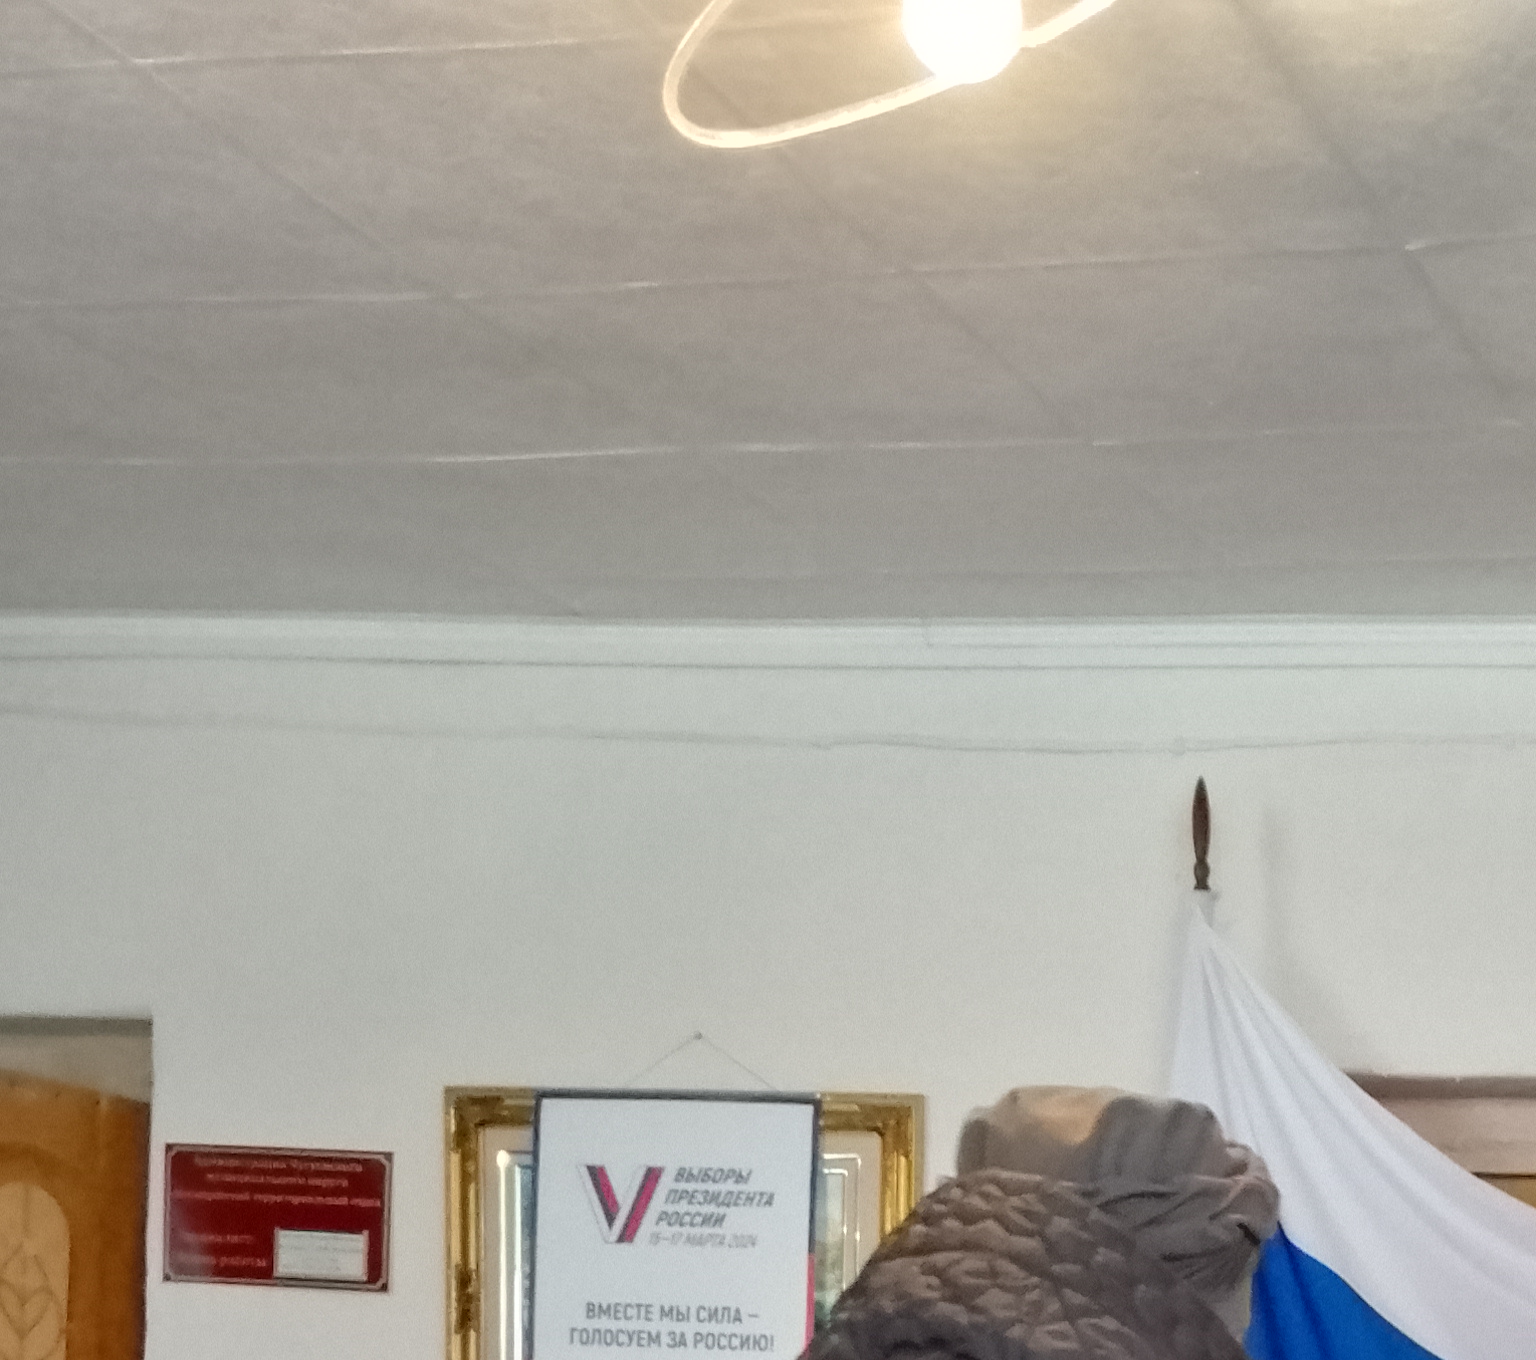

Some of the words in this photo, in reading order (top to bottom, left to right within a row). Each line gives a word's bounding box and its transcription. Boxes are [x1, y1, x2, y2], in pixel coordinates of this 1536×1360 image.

[673, 1166, 752, 1185] ВЫБОРЫ
[664, 1188, 776, 1208] ПРЕЗИДЕНТА
[655, 1210, 727, 1228] РОССИИ
[586, 1301, 655, 1322] ВМЕСТЕ
[659, 1305, 691, 1323] МЫ
[696, 1305, 744, 1324] СИЛА
[569, 1327, 662, 1348] ГОЛОСУЕМ
[666, 1330, 688, 1349] ЗА
[693, 1332, 775, 1353] РОССИЮ!
